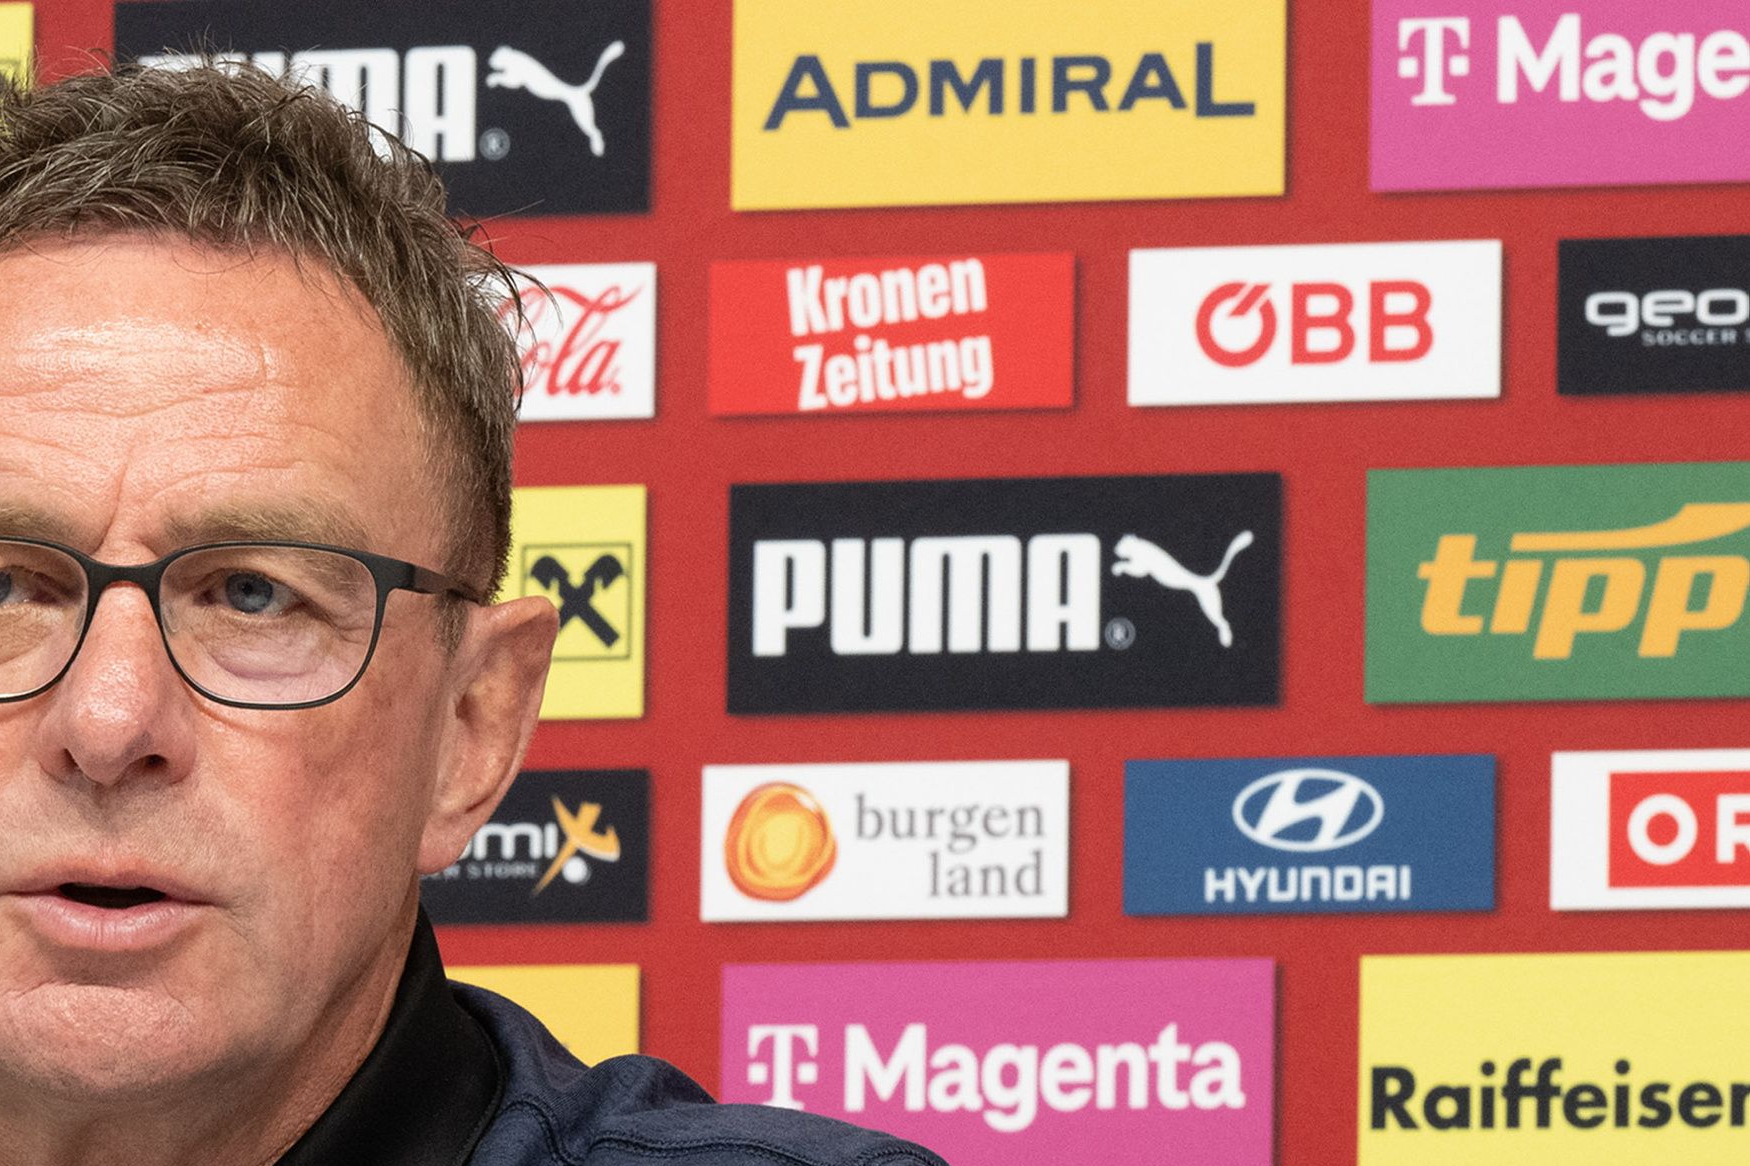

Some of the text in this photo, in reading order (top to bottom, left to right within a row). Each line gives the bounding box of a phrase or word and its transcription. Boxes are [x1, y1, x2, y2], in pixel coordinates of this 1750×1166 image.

[762, 41, 1257, 132] ADMIRAL
[1496, 12, 1750, 121] Mage
[786, 256, 987, 337] Kronen
[1584, 288, 1750, 337] geo
[1641, 328, 1737, 346] SOCCER
[793, 331, 994, 413] Zeitung
[752, 533, 1102, 656] PUMA
[1417, 503, 1750, 660] tipp
[854, 791, 1045, 844] burgen
[1626, 792, 1750, 866] OR
[928, 848, 1045, 901] land
[1204, 865, 1411, 902] HYUNDAI
[843, 1021, 1246, 1134] Magenta
